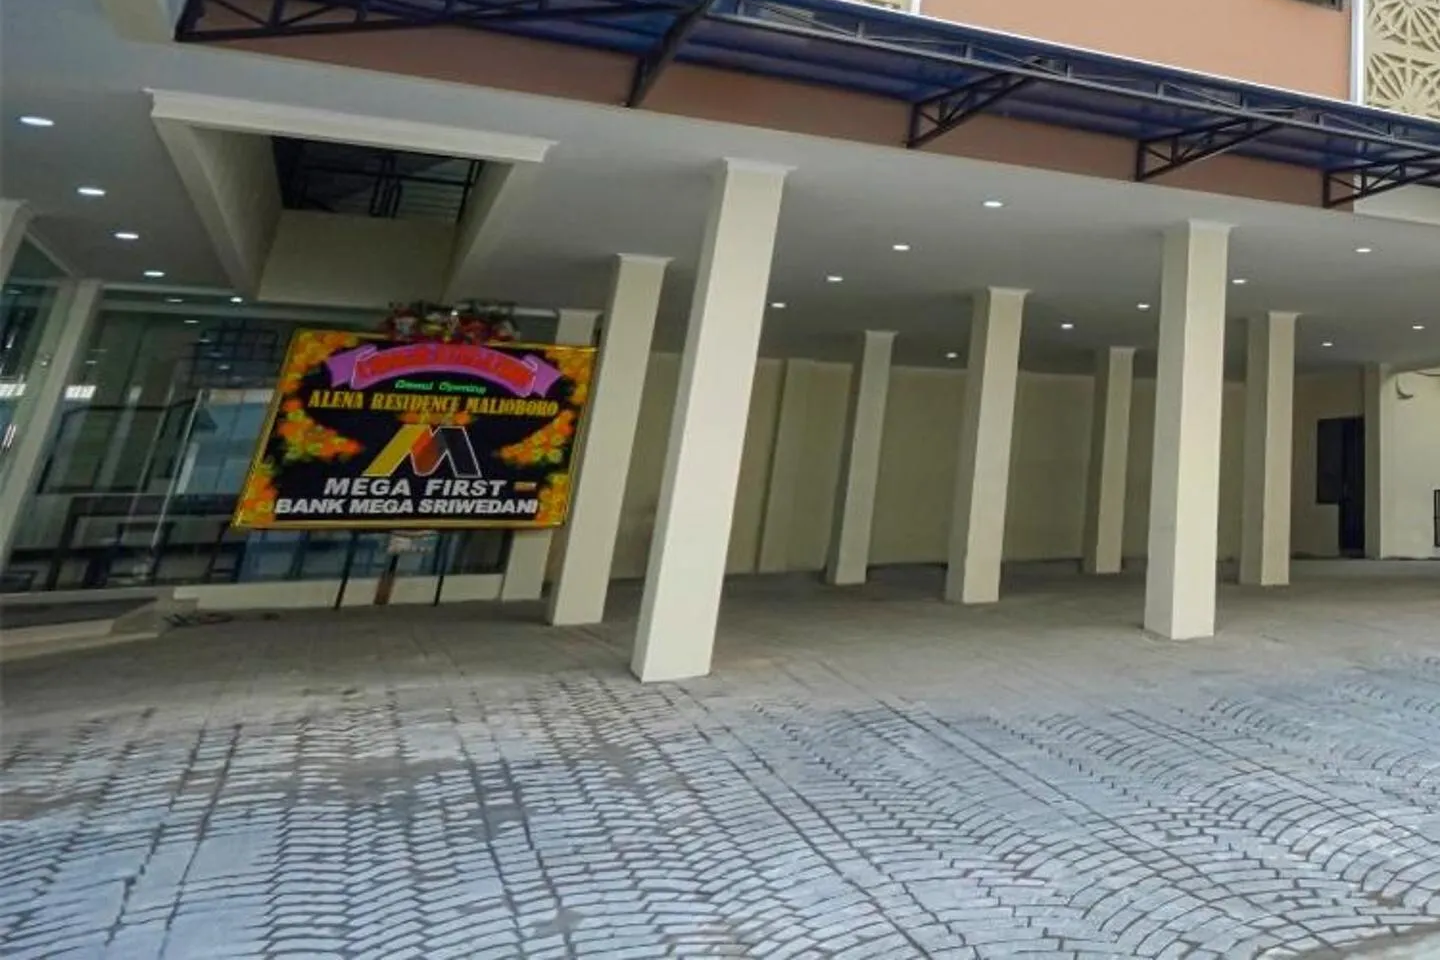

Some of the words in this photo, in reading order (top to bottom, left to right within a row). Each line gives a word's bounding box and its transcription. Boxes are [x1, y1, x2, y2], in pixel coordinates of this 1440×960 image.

[308, 390, 364, 409] ALENA
[323, 477, 411, 496] MEGA
[425, 478, 507, 496] FIRST
[275, 498, 346, 514] BANK
[349, 498, 414, 514] MEGA
[418, 498, 538, 514] SRIWEDANI
